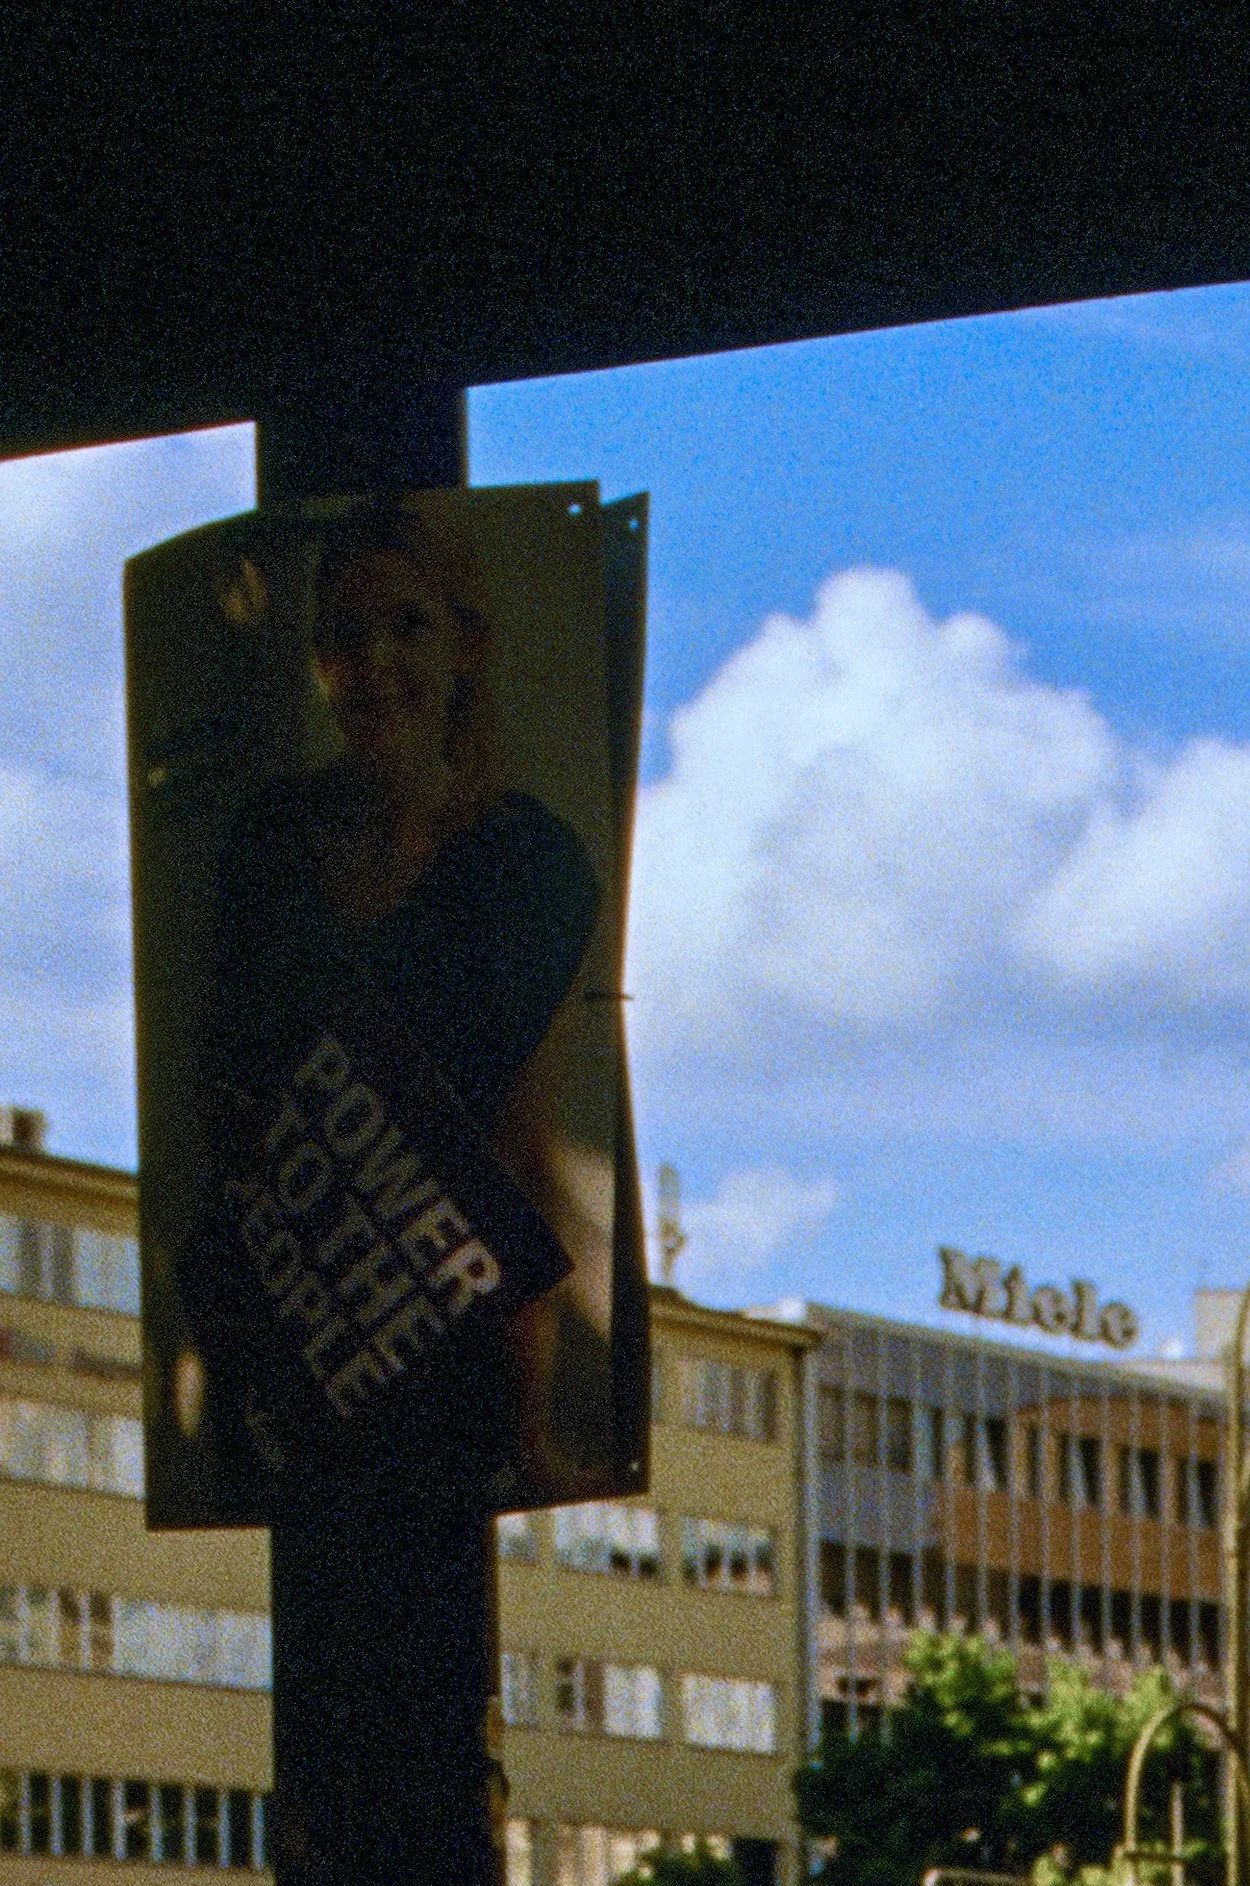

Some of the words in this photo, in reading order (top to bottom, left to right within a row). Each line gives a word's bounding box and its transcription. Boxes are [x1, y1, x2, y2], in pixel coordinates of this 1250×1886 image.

[262, 1090, 332, 1214] TO
[316, 1193, 446, 1374] THE
[294, 1032, 503, 1317] POWER
[937, 1246, 1138, 1350] Miele
